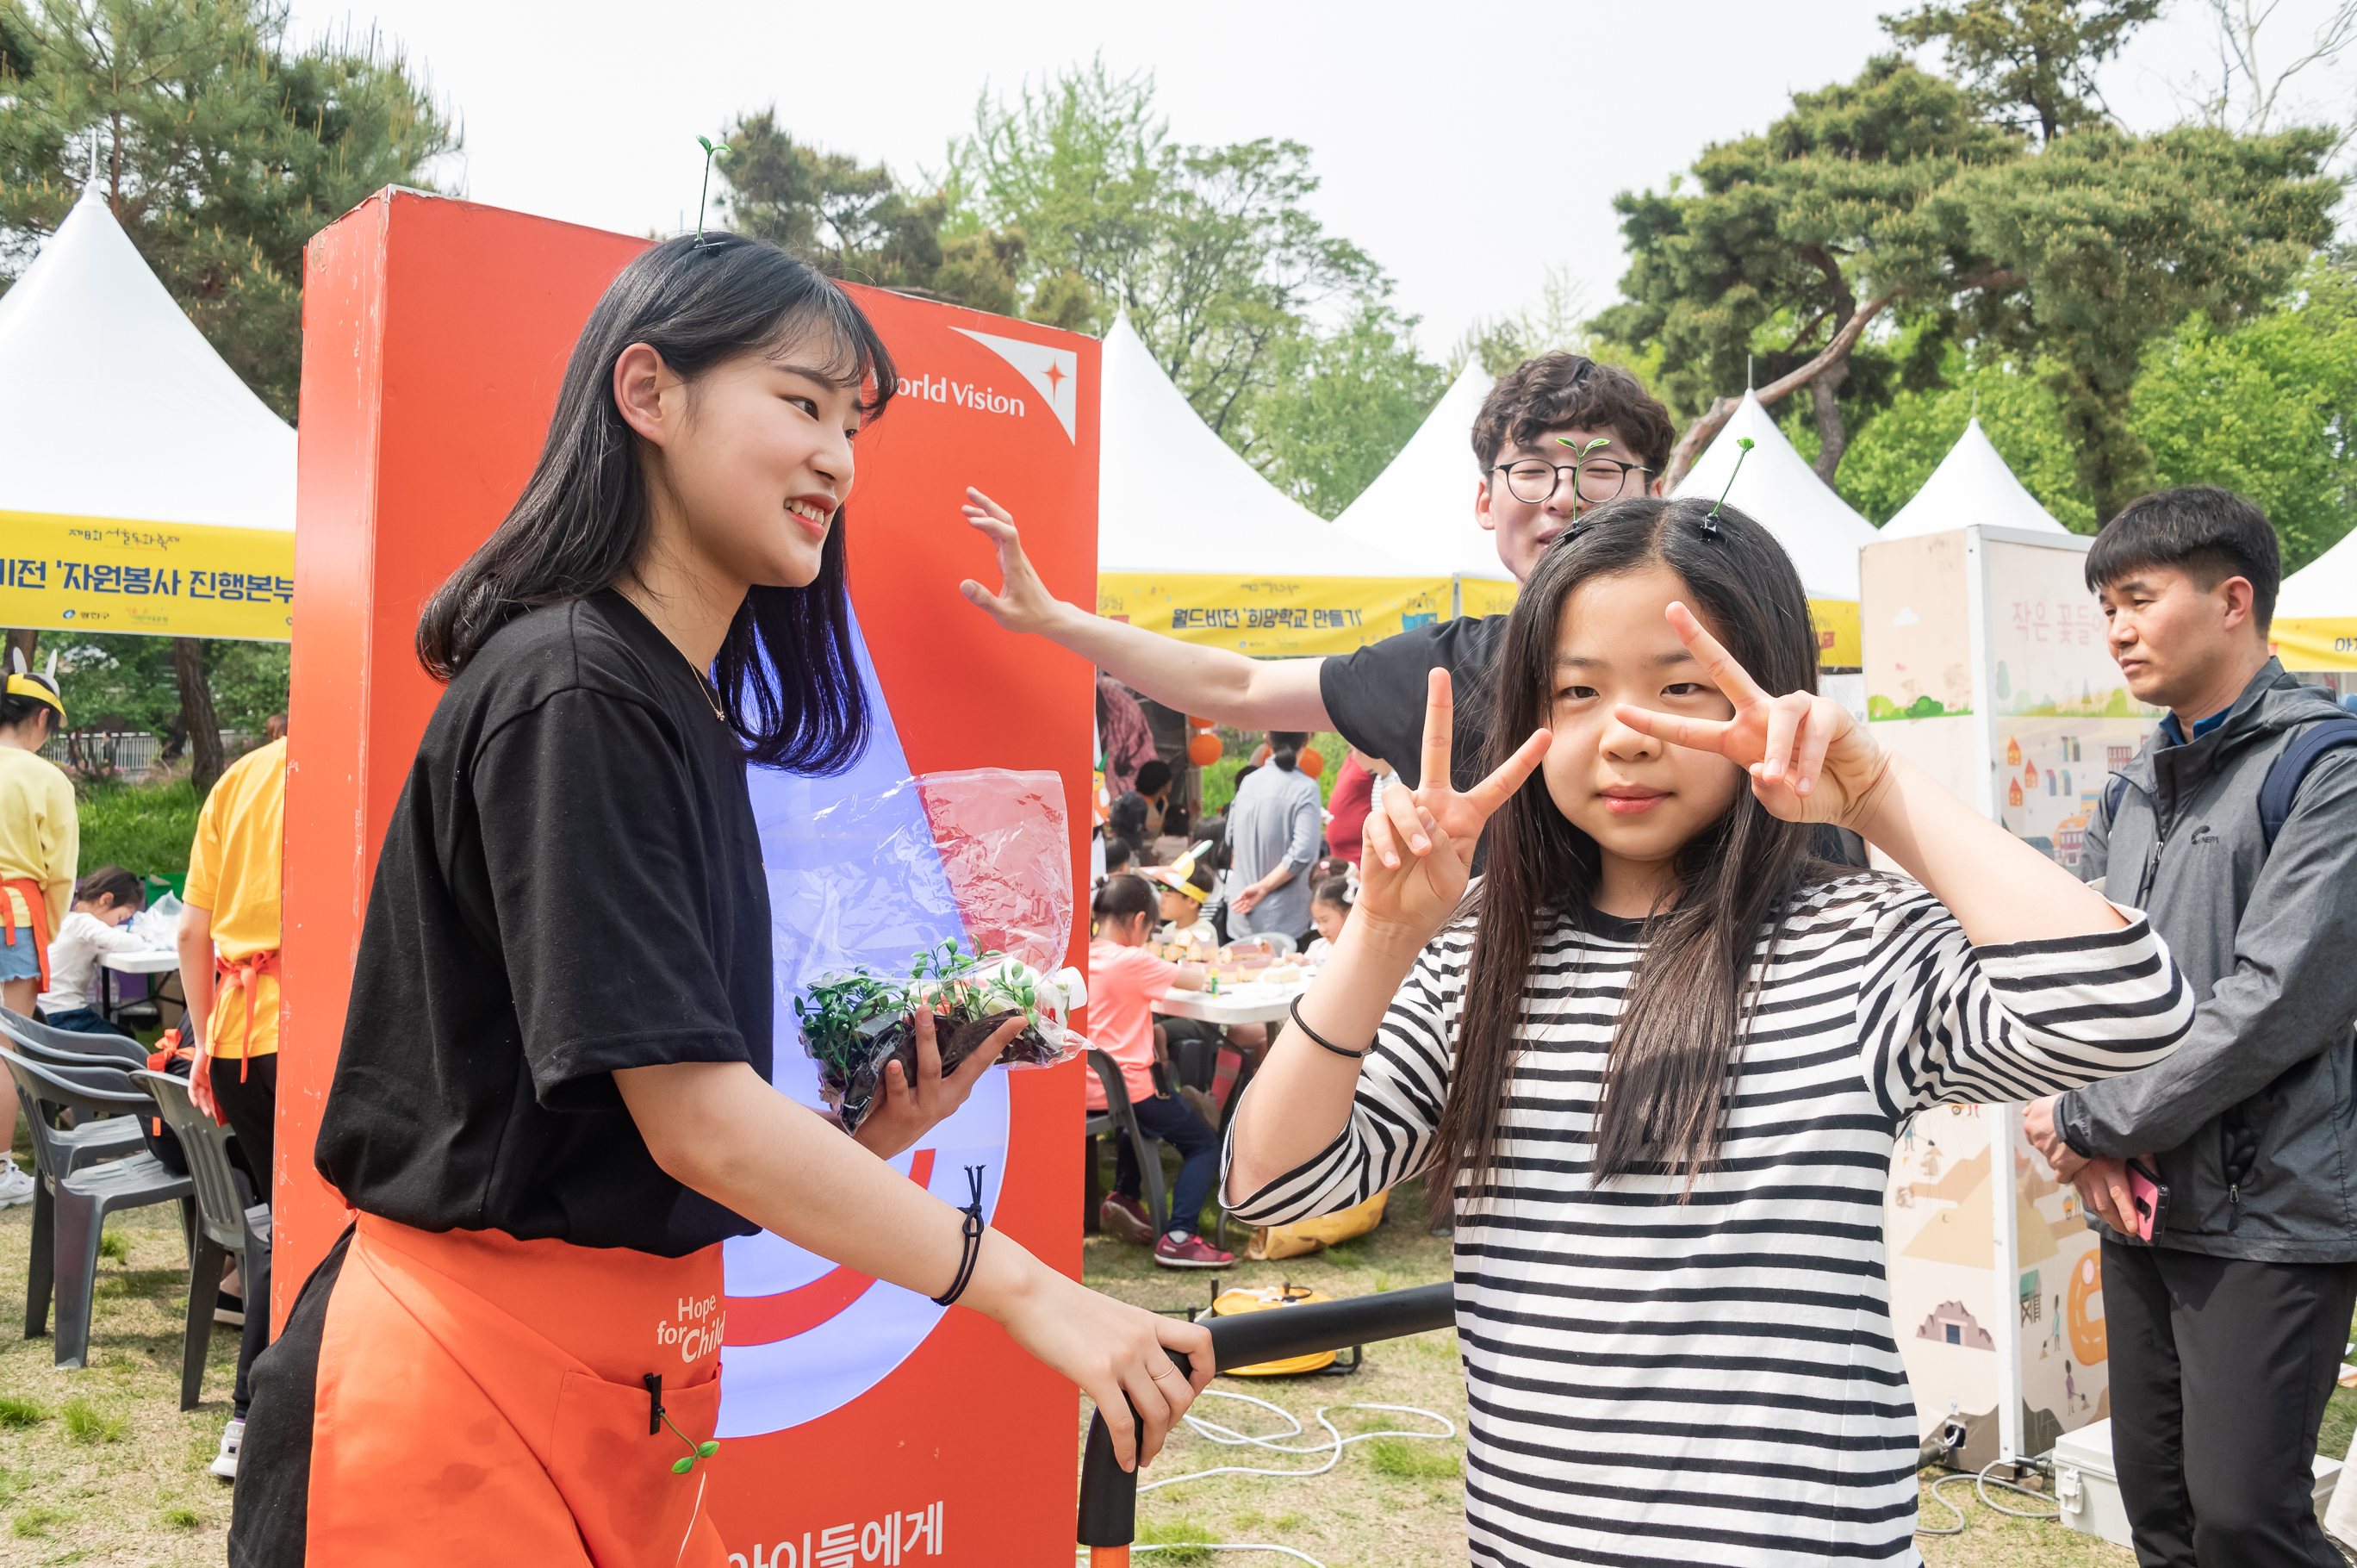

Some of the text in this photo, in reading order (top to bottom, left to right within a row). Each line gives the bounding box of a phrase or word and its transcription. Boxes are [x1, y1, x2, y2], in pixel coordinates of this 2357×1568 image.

[898, 374, 1024, 417] orld Vision
[189, 569, 294, 604] 진행본부
[1172, 608, 1240, 629] 월드비전
[2012, 601, 2049, 642] 작은
[678, 1295, 716, 1323] Hope
[657, 1310, 726, 1363] for Child
